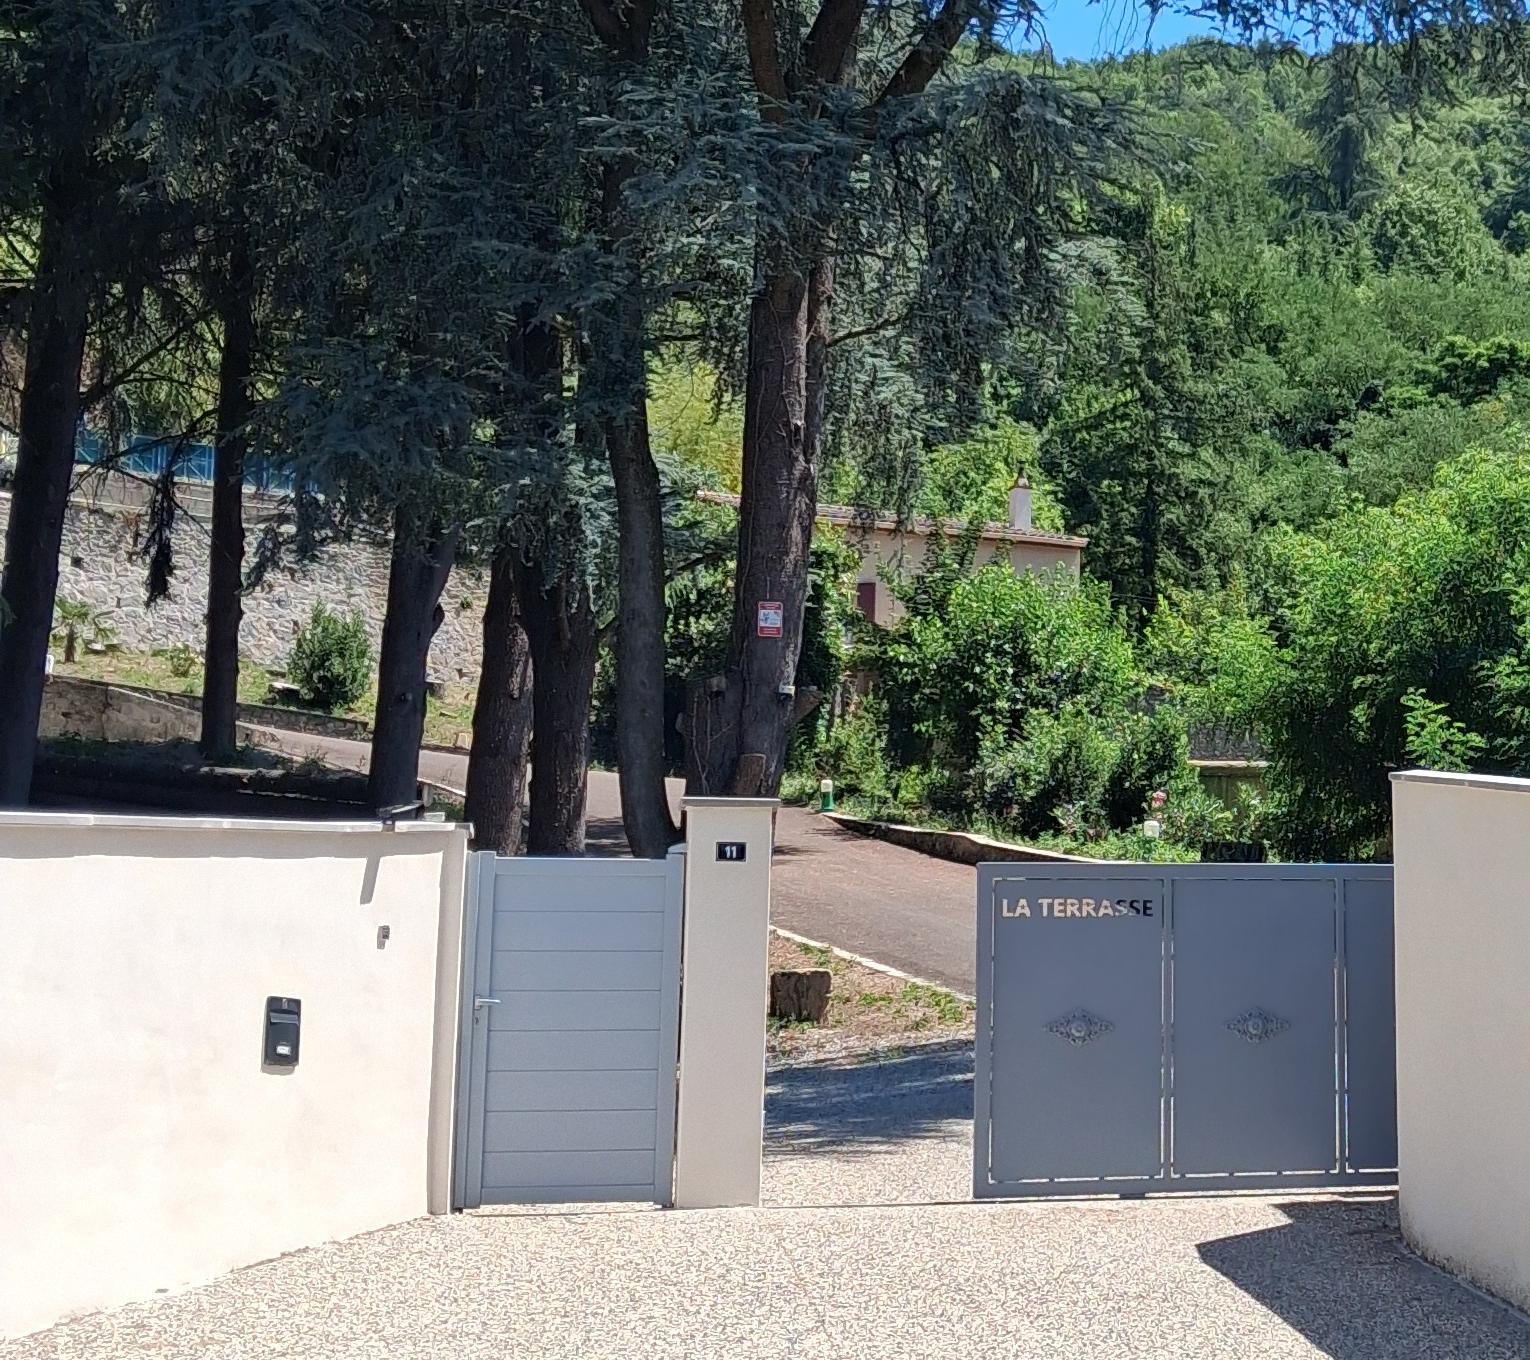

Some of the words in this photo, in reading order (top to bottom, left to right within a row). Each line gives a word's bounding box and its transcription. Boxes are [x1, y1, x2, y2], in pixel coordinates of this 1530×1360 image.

[725, 845, 737, 859] 11
[1002, 898, 1031, 918] LA
[1038, 898, 1154, 918] TERRASSE
